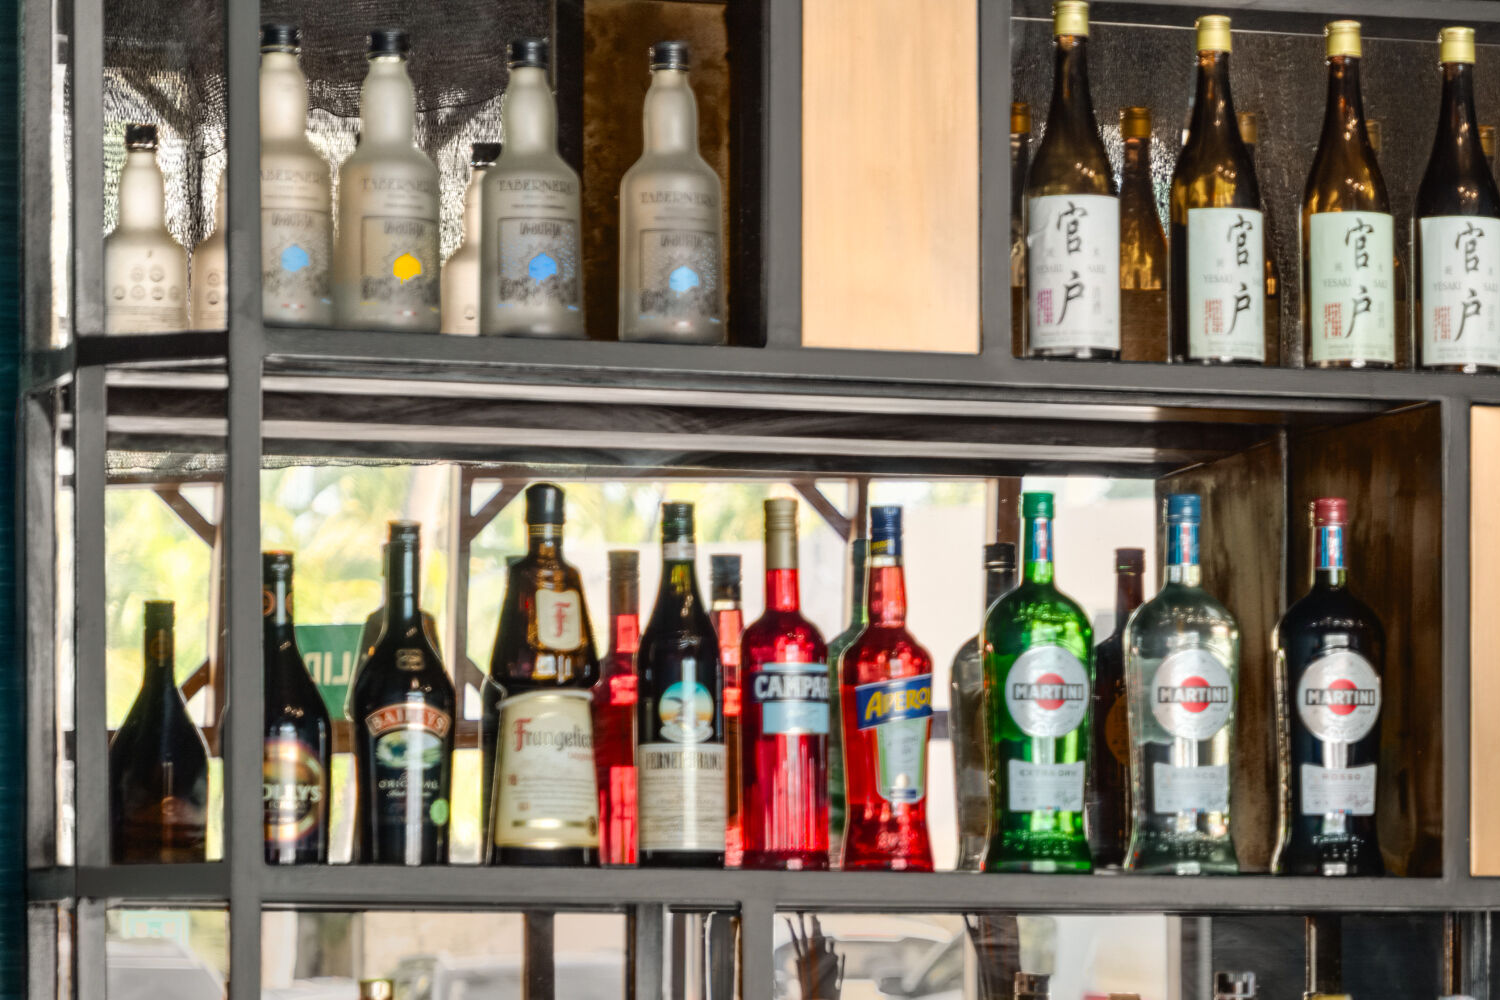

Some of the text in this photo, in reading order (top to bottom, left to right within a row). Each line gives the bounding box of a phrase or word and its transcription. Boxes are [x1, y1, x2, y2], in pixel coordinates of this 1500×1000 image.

[1015, 684, 1083, 699] MARTINI
[1160, 687, 1227, 702] MARTINI
[1306, 690, 1375, 705] MARTINI
[371, 706, 445, 730] BAILEYS
[378, 779, 439, 789] ORIGNAL
